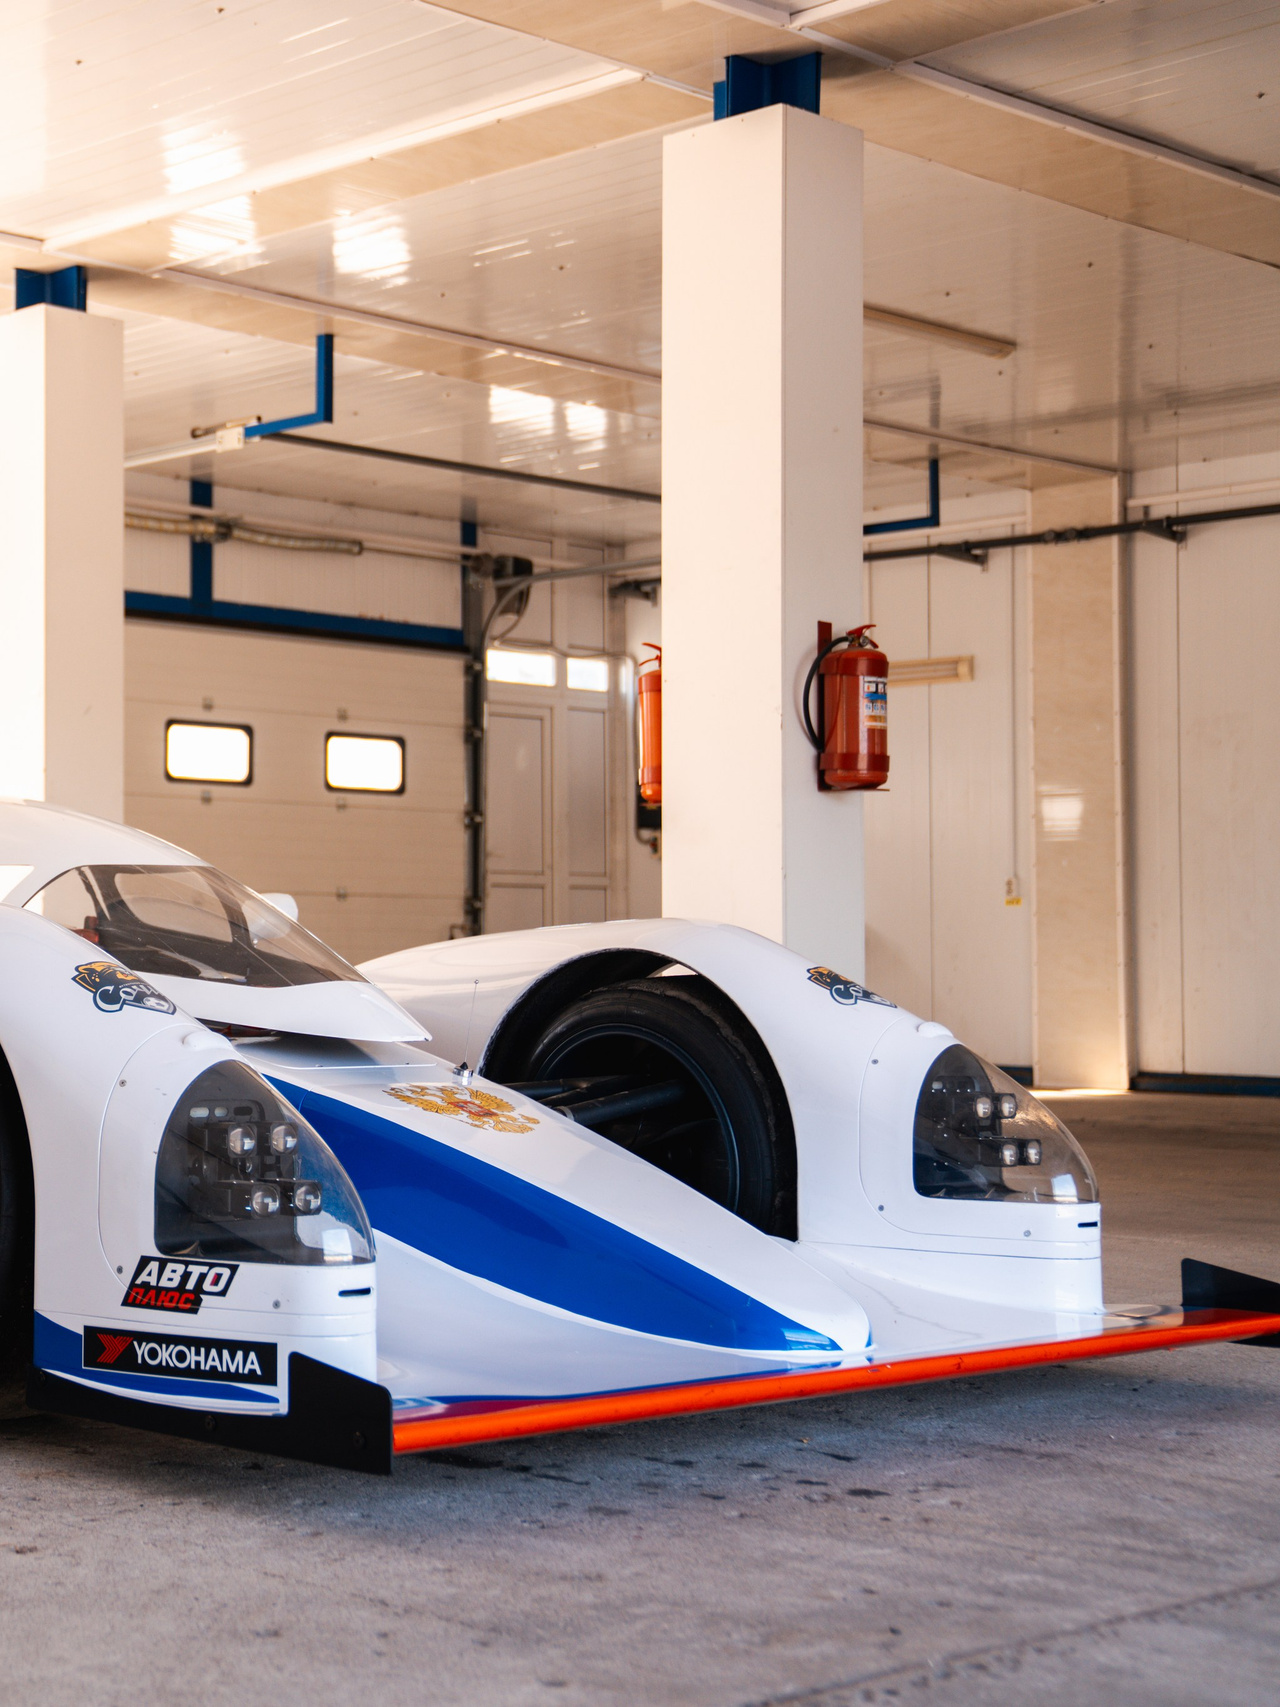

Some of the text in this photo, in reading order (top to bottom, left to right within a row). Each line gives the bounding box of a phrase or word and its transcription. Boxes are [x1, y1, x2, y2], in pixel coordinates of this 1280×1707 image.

[134, 1260, 232, 1293] АВТО
[126, 1287, 196, 1310] ПЛЮС
[132, 1339, 263, 1376] YOKOHAMA
